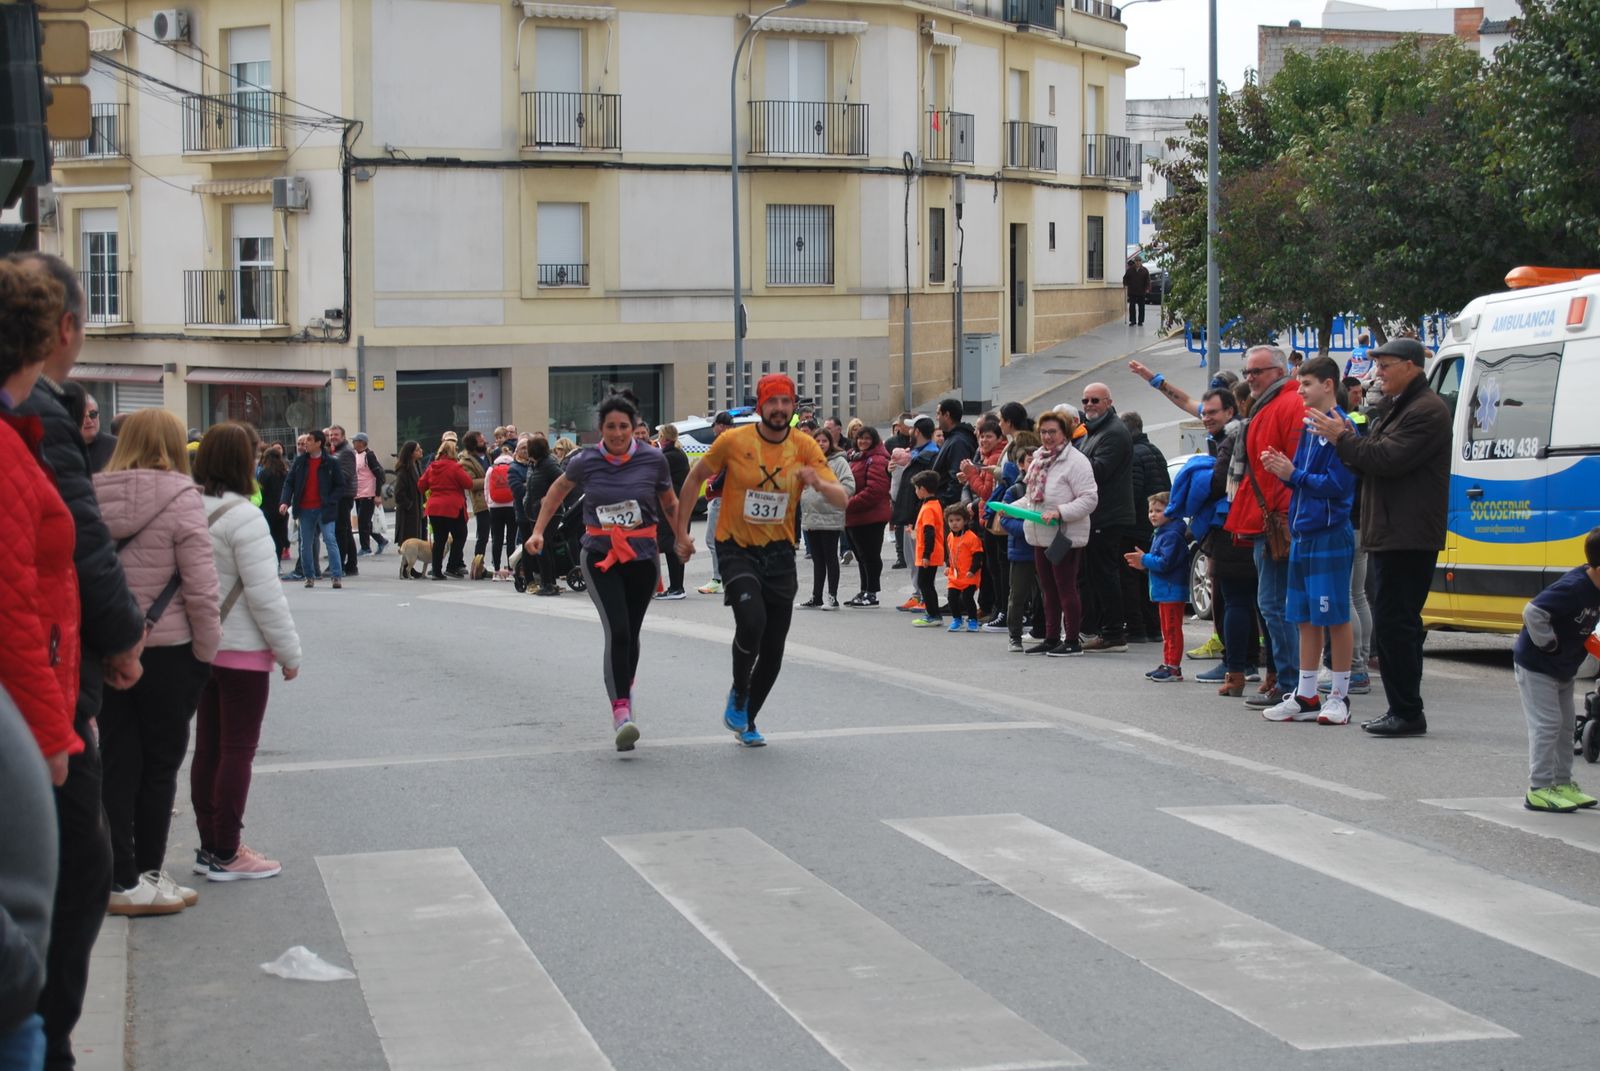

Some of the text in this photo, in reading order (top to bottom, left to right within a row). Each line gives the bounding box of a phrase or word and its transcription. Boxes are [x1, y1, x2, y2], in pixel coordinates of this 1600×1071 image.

[1491, 309, 1555, 333] AMBULANCIA
[1472, 437, 1538, 459] 627 438 438
[608, 512, 635, 525] 332
[751, 503, 778, 517] 331
[1471, 500, 1531, 520] SOCOSERVIS
[1319, 596, 1328, 612] 5
